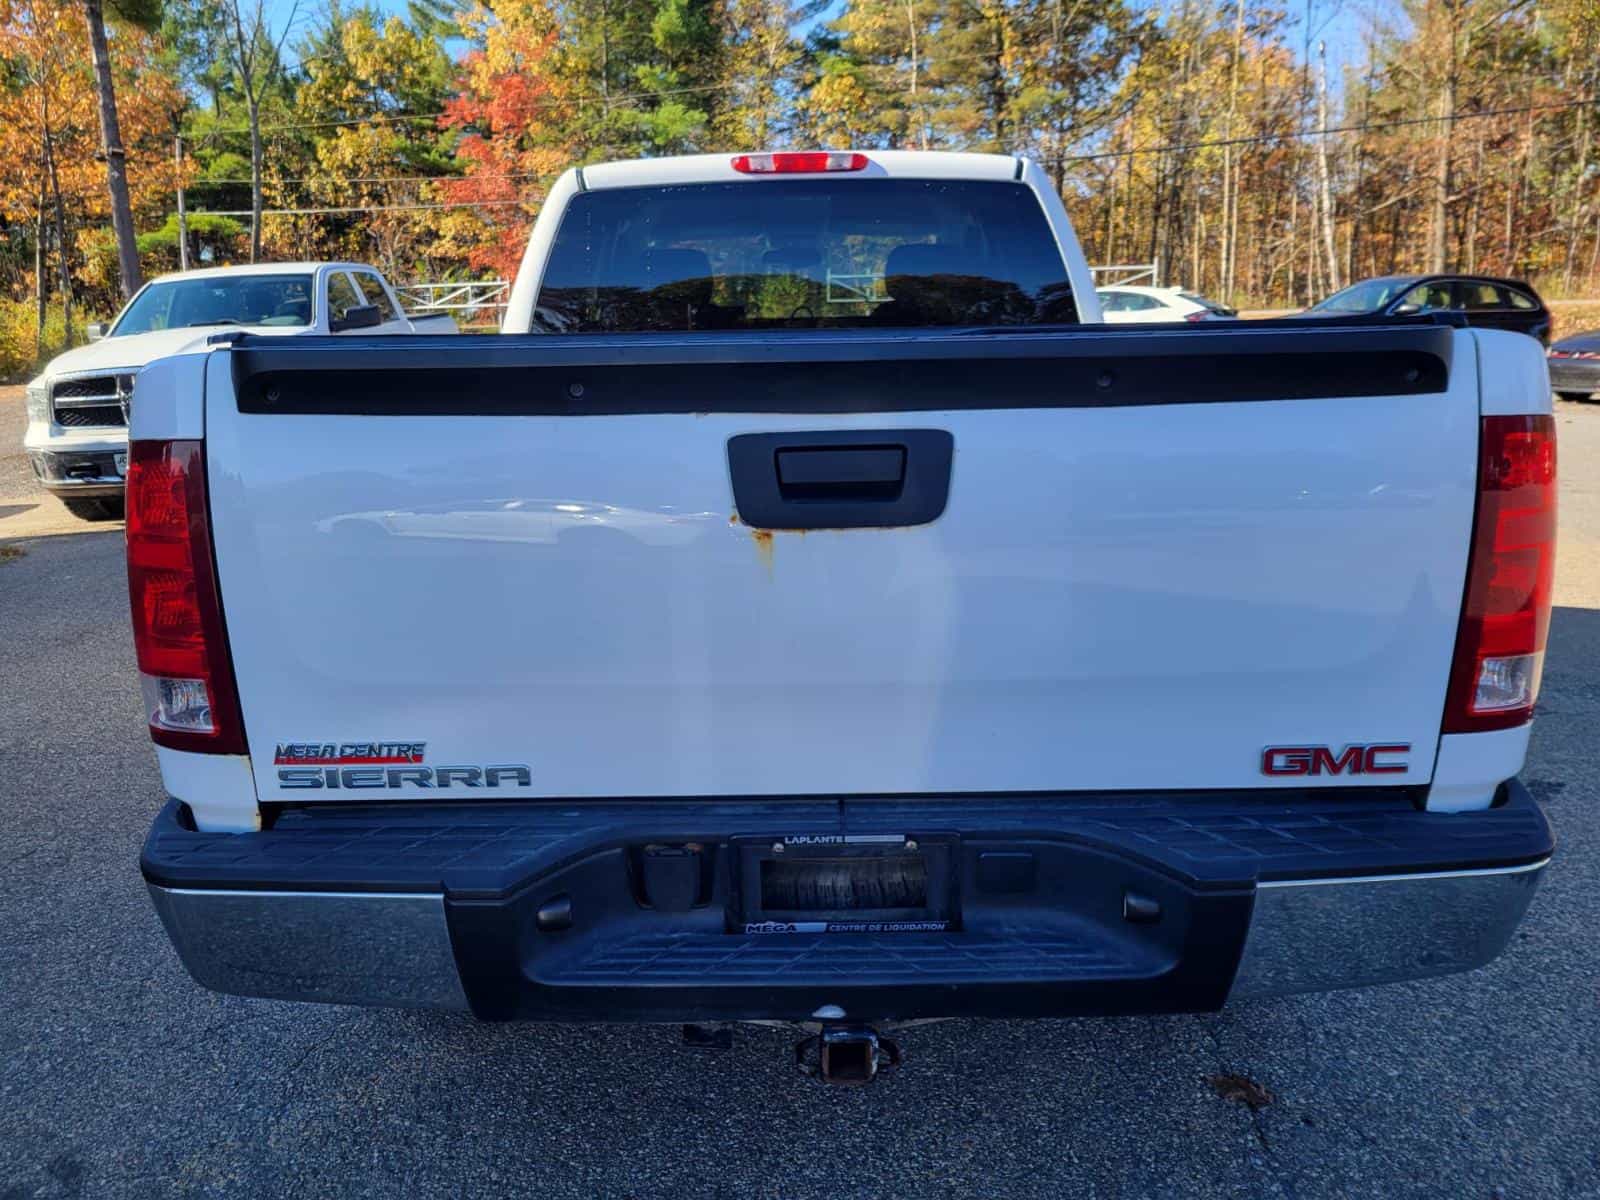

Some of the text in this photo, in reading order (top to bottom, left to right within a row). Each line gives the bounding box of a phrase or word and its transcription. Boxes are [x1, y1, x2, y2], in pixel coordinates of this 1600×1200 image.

[275, 742, 426, 761] MEGA CENTRE
[1261, 743, 1411, 776] GMC
[278, 766, 532, 789] SIERRA
[784, 835, 843, 845] LAPLANTE
[829, 923, 866, 932] CENTRE
[868, 923, 881, 932] DE
[883, 923, 945, 932] LIQUIDATION
